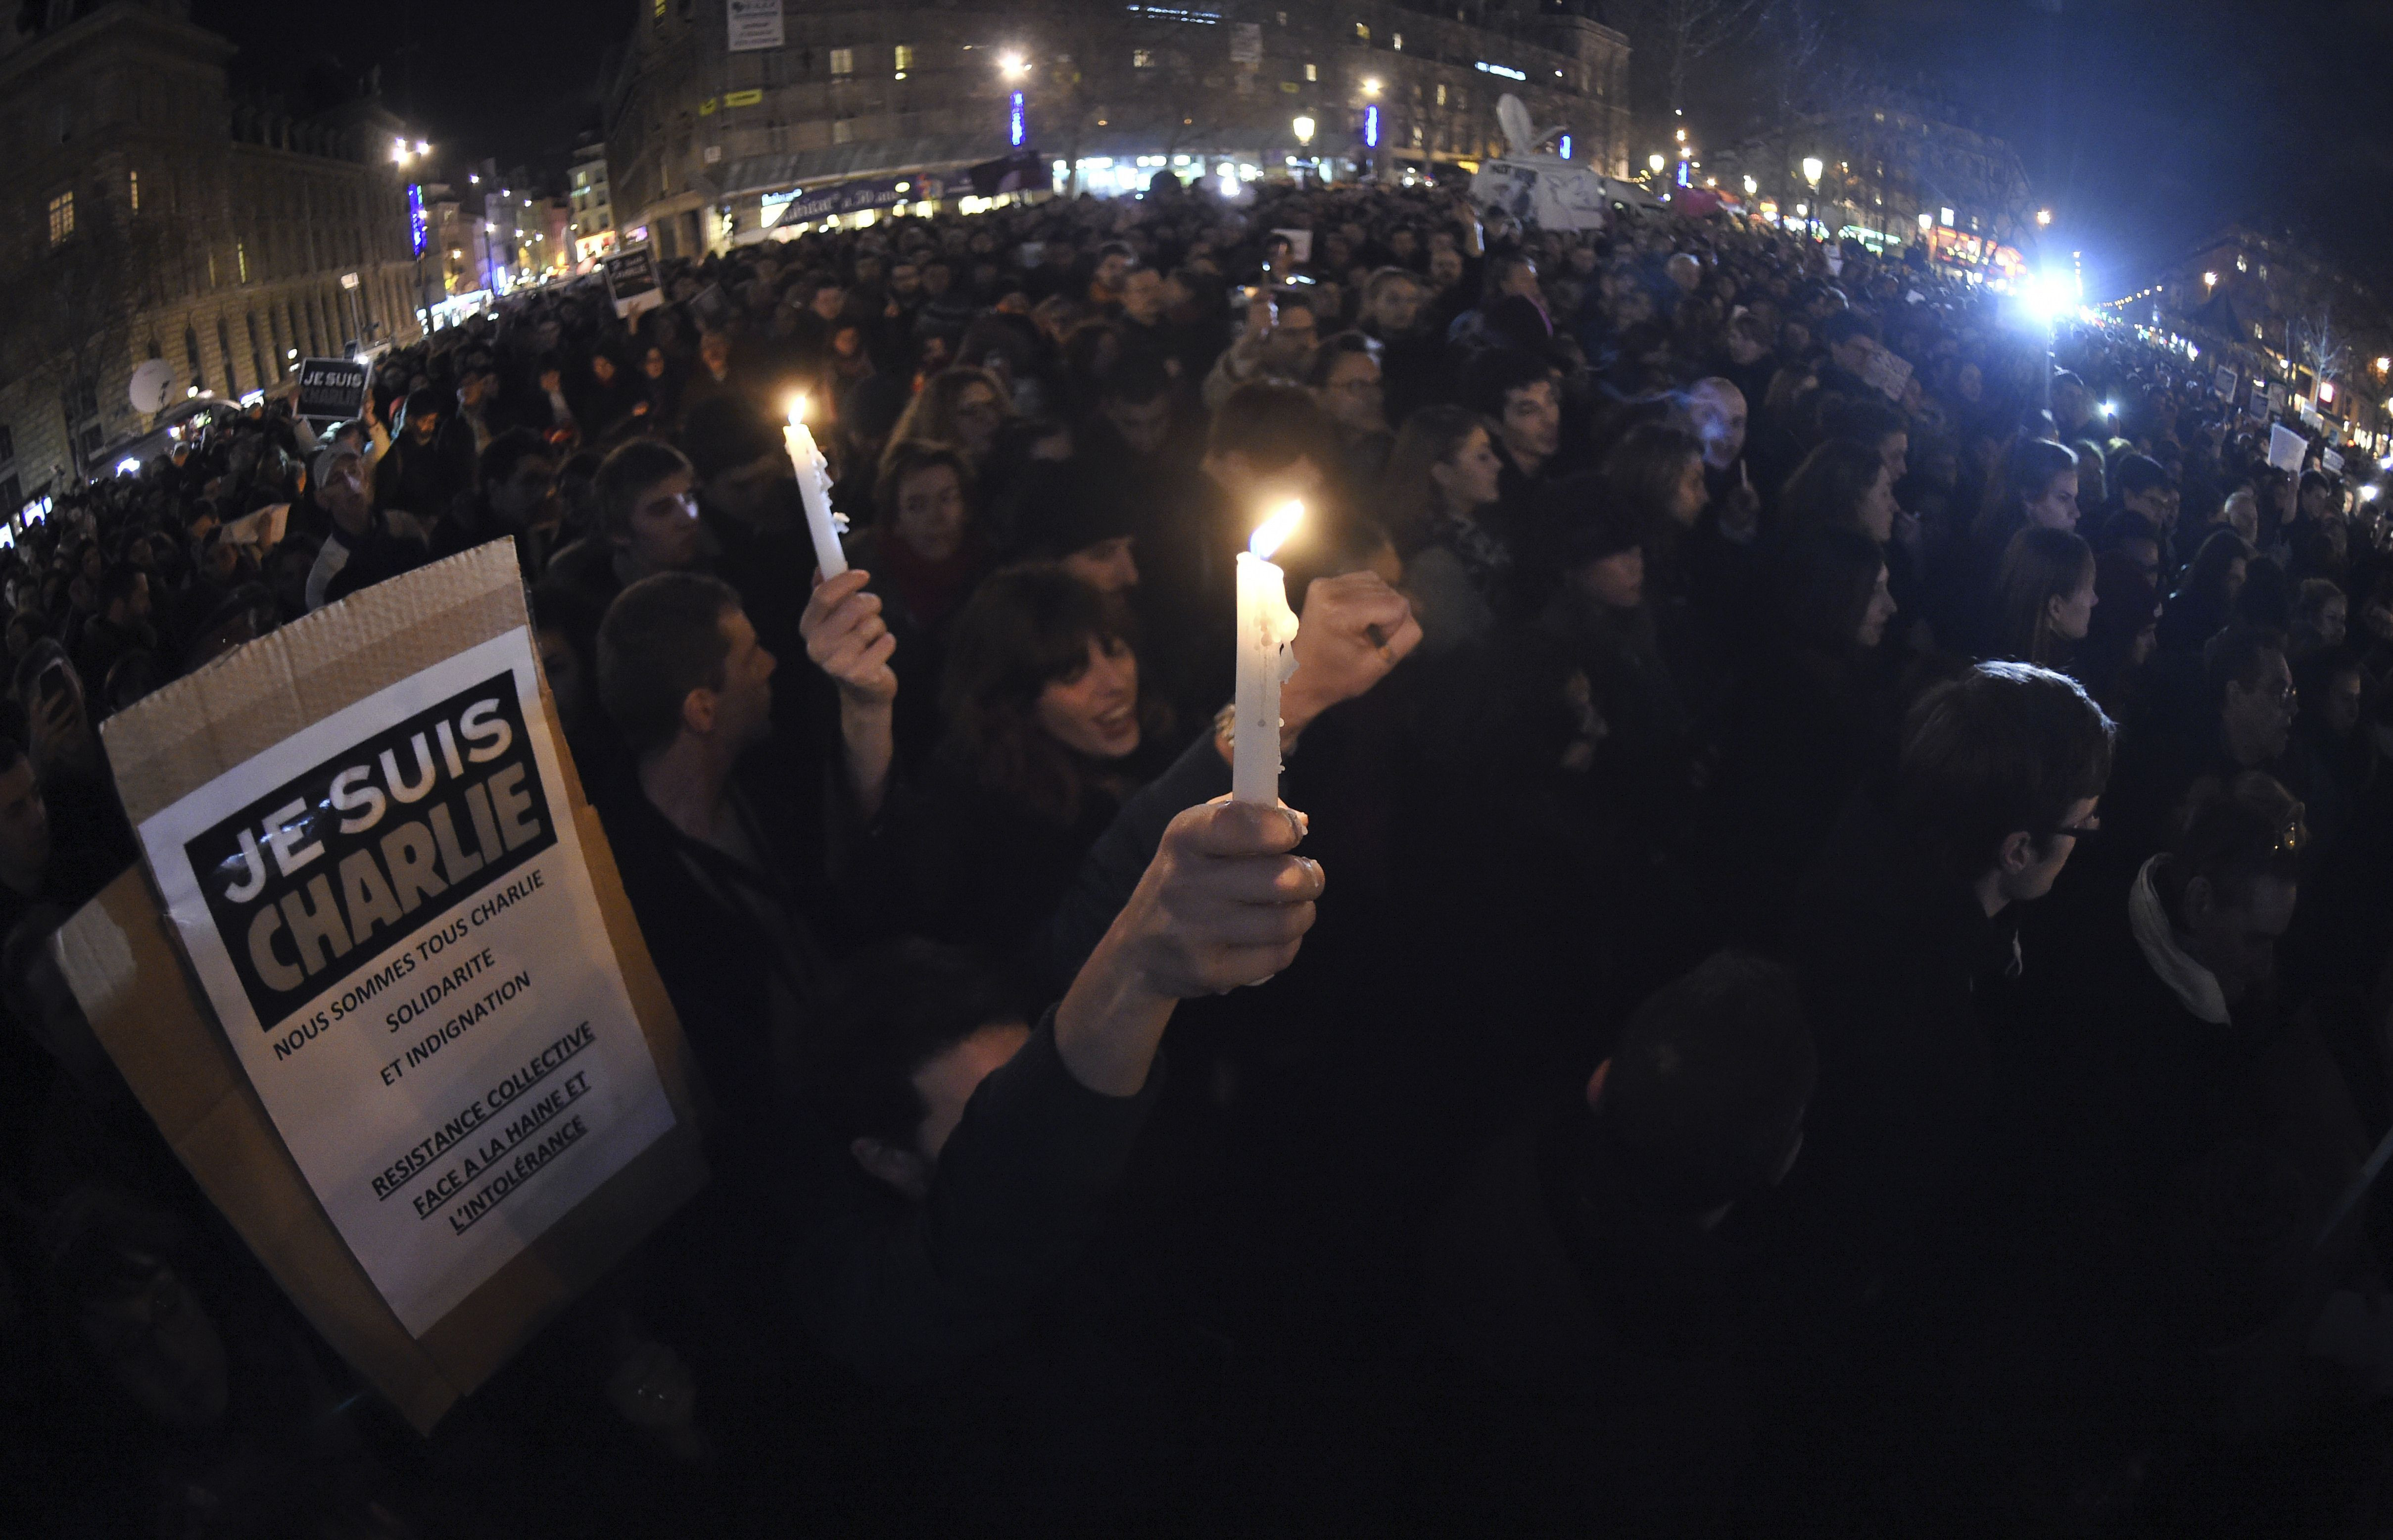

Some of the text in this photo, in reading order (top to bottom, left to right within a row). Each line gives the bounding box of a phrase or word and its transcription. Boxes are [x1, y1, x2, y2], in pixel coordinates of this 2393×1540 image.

[303, 371, 362, 388] JE SUIS
[224, 698, 513, 903] JE SUIS
[248, 762, 541, 993] CHARLIE
[273, 868, 545, 1061] NOUS SOMMES TOUS CHARLIE
[380, 970, 531, 1087] ET INDIGNATION
[386, 947, 495, 1033] SOLIDARITE
[371, 1021, 595, 1199] RESISTANCE COLLECTIVE
[413, 1070, 589, 1216] FACE A LA HAINE ET
